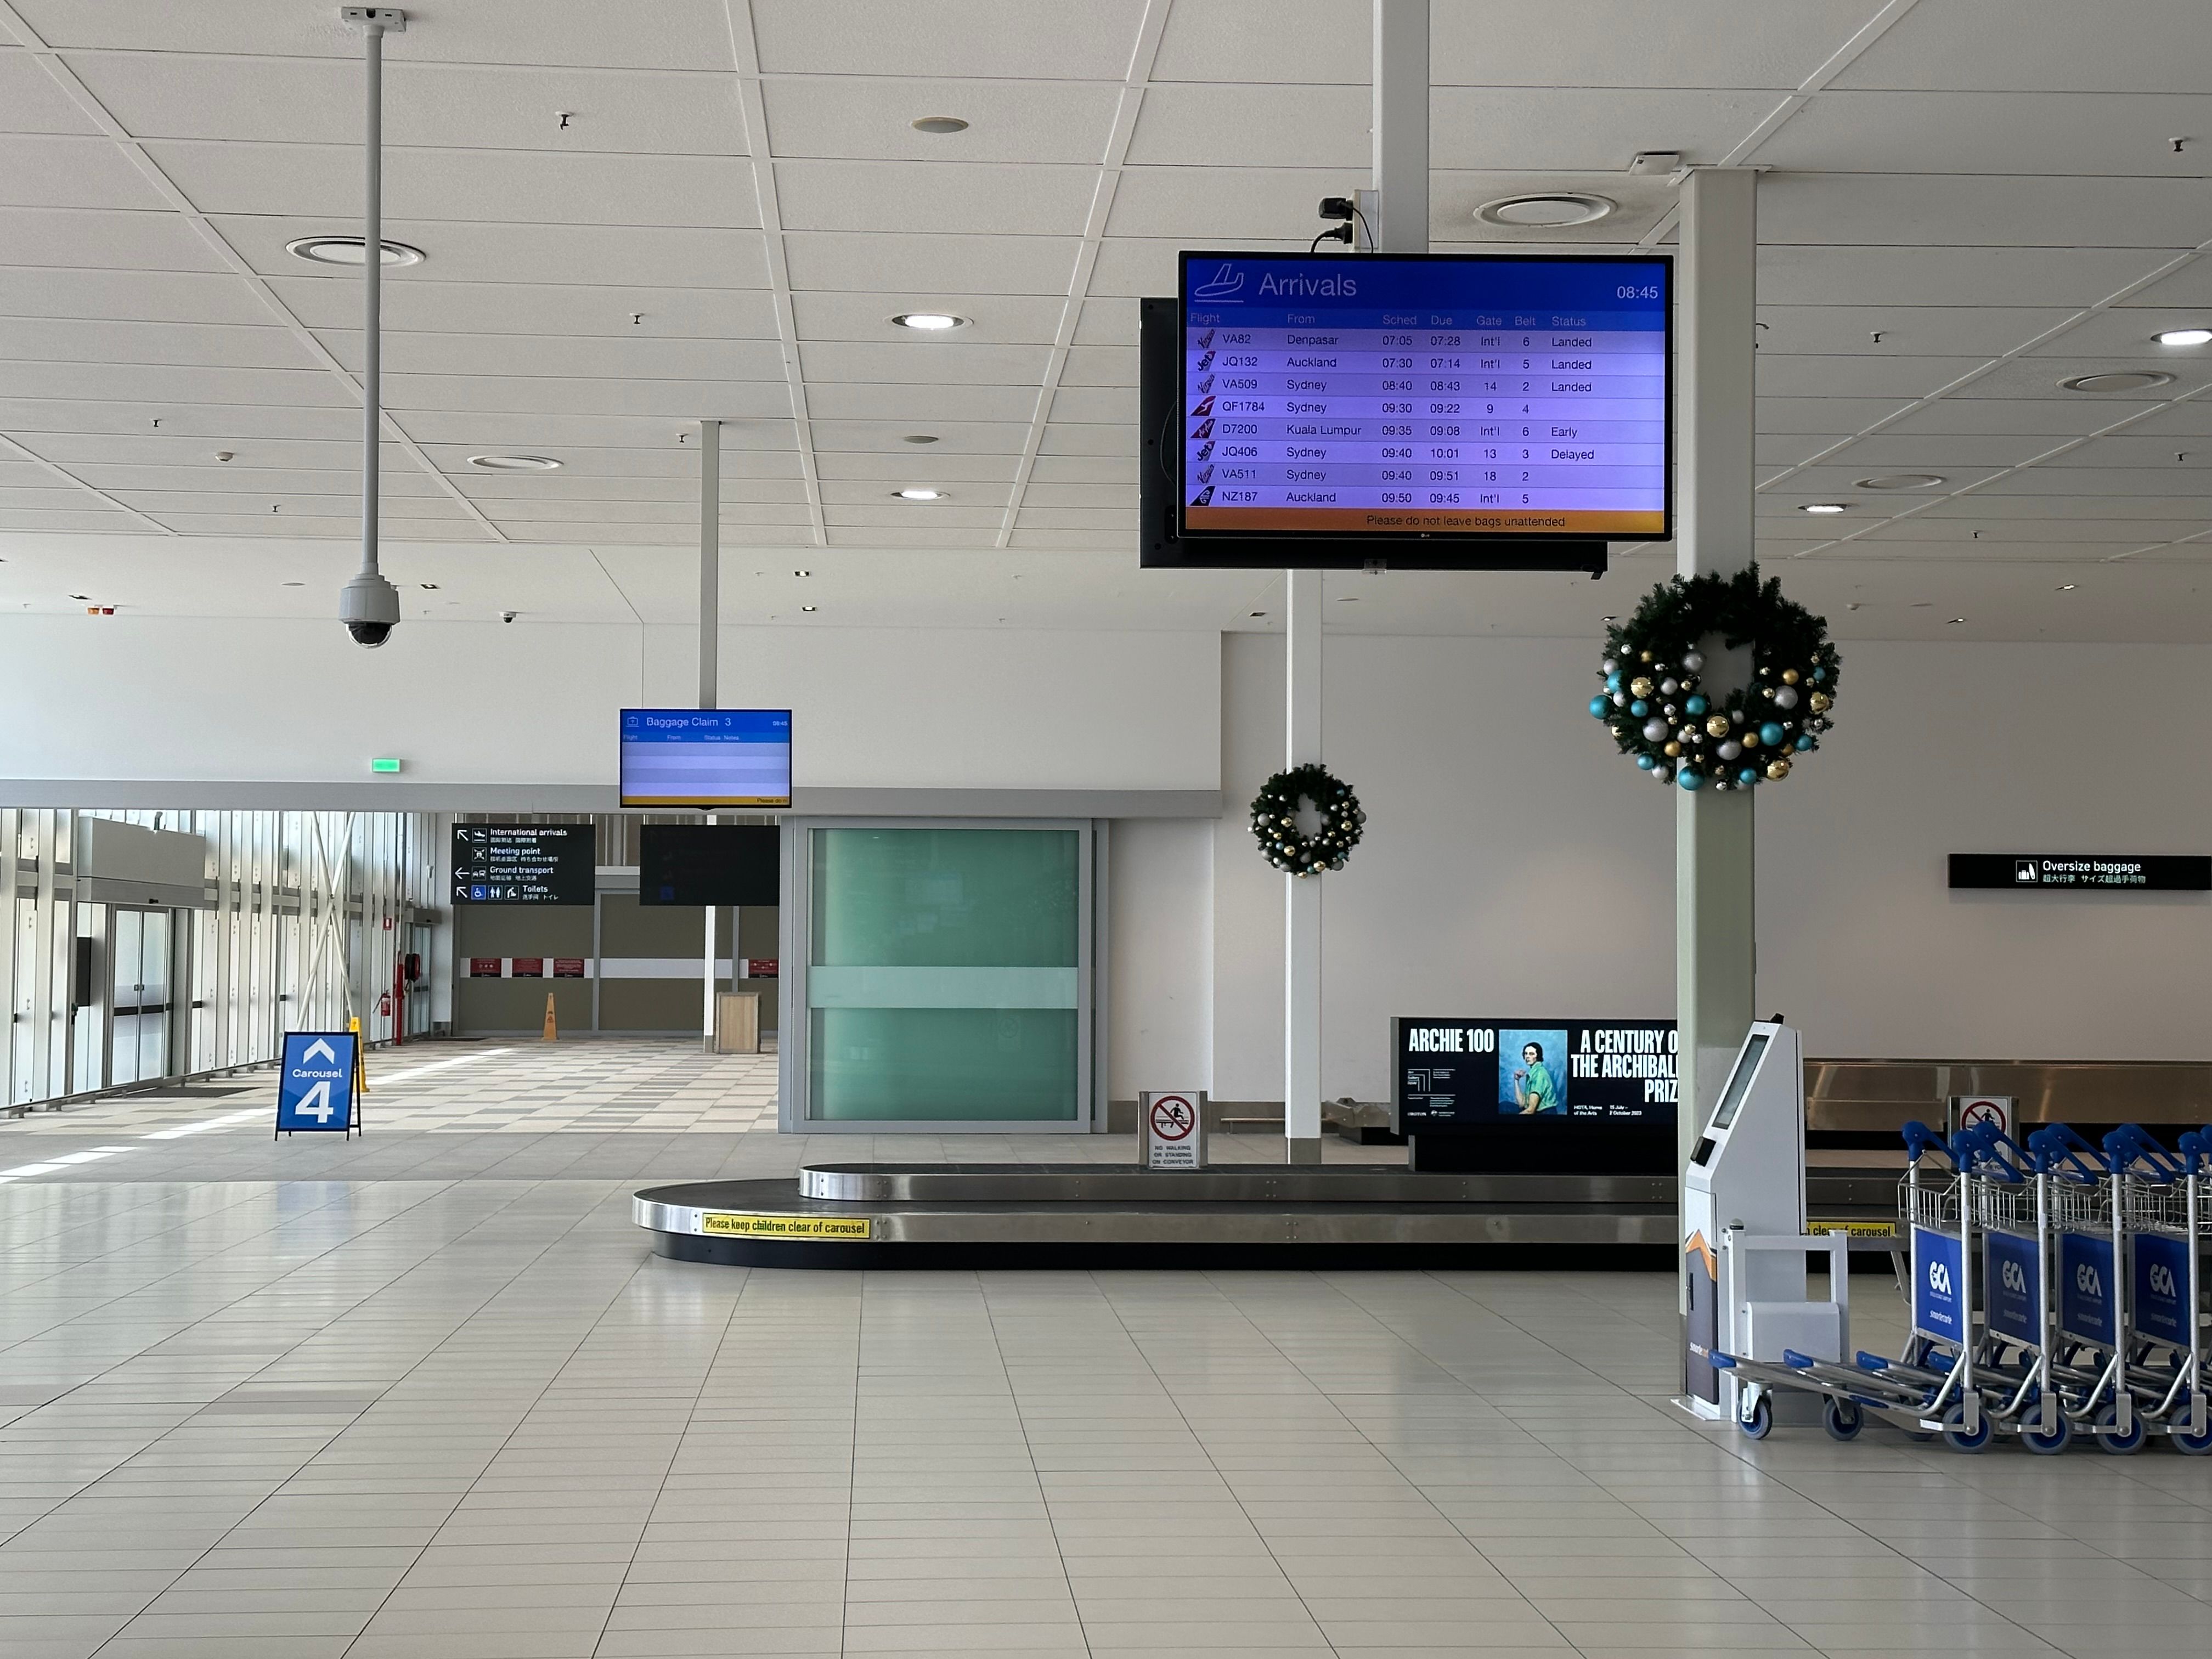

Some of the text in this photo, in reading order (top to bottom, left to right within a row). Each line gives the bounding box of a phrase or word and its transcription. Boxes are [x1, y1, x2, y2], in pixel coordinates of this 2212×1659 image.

[1259, 273, 1357, 296] Arrivals
[1616, 286, 1658, 299] 08:45
[1190, 313, 1586, 326] Flight From Sched Due Gate Belt Status
[1222, 334, 1251, 344] VA82
[1288, 335, 1339, 346] Denpasar
[1383, 335, 1413, 346] 07:05
[1430, 336, 1461, 346] 07:28
[1481, 337, 1501, 347] Int'l
[1523, 337, 1530, 347] 6
[1552, 337, 1592, 347] Landed
[1222, 357, 1258, 367] JQ132
[1286, 358, 1337, 368] Auckland
[1383, 358, 1413, 369] 07:30
[1430, 358, 1460, 369] 07:14
[1481, 359, 1500, 369] Int'l
[1523, 359, 1530, 370] 5
[1551, 359, 1592, 370] Landed
[1222, 379, 1258, 389] VA509
[1286, 380, 1327, 392] Sydney
[1382, 381, 1413, 391] 08:40
[1430, 381, 1460, 392] 08:43
[1485, 382, 1497, 392] 14
[1522, 382, 1530, 392] 2
[1551, 382, 1592, 392] Landed
[1222, 402, 1530, 414] QF1784 Sydney 09:30 09:22 9 4
[1223, 424, 1257, 435] D7200
[1286, 424, 1317, 435] Kuala
[1321, 425, 1362, 437] Lumpur
[1382, 426, 1412, 436] 09:35
[1430, 426, 1460, 436] 09:08
[1481, 426, 1500, 437] Int'l
[1522, 426, 1530, 437] 6
[1551, 427, 1578, 439] Early
[1222, 447, 1258, 457] JQ406
[1286, 447, 1327, 459] Sydney
[1382, 448, 1412, 459] 09:40
[1430, 448, 1459, 459] 10:01
[1484, 449, 1497, 459] 13
[1522, 449, 1530, 459] 3
[1551, 449, 1594, 461] Delayed
[1222, 469, 1256, 479] VA511
[1286, 470, 1327, 482] Sydney
[1382, 471, 1412, 481] 09:40
[1430, 471, 1459, 481] 09:51
[1484, 471, 1497, 482] 18
[1522, 472, 1530, 482] 2
[1222, 492, 1530, 504] NZ187 Auckland 09:50 09:45 Int'l 5
[1367, 515, 1565, 527] Please do not leave bags unattended
[647, 717, 731, 728] Baggage Claim 3
[490, 847, 540, 856] Meeting point
[2042, 860, 2141, 873] Oversize baggage
[1409, 1028, 1494, 1052] ARCHIE 100
[1581, 1030, 1678, 1053] A CENTURY O
[1571, 1054, 1678, 1078] THE ARCHIBAL
[292, 1069, 342, 1078] Carousel
[1645, 1079, 1678, 1103] PRIZ
[295, 1081, 334, 1123] 4
[706, 1217, 865, 1233] Please keep children clear of carousel
[1851, 1226, 1890, 1237] carousel
[1929, 1261, 1951, 1295] GCA
[2003, 1260, 2027, 1294] GCA
[2077, 1263, 2102, 1297] GCA
[2150, 1263, 2176, 1297] GCA
